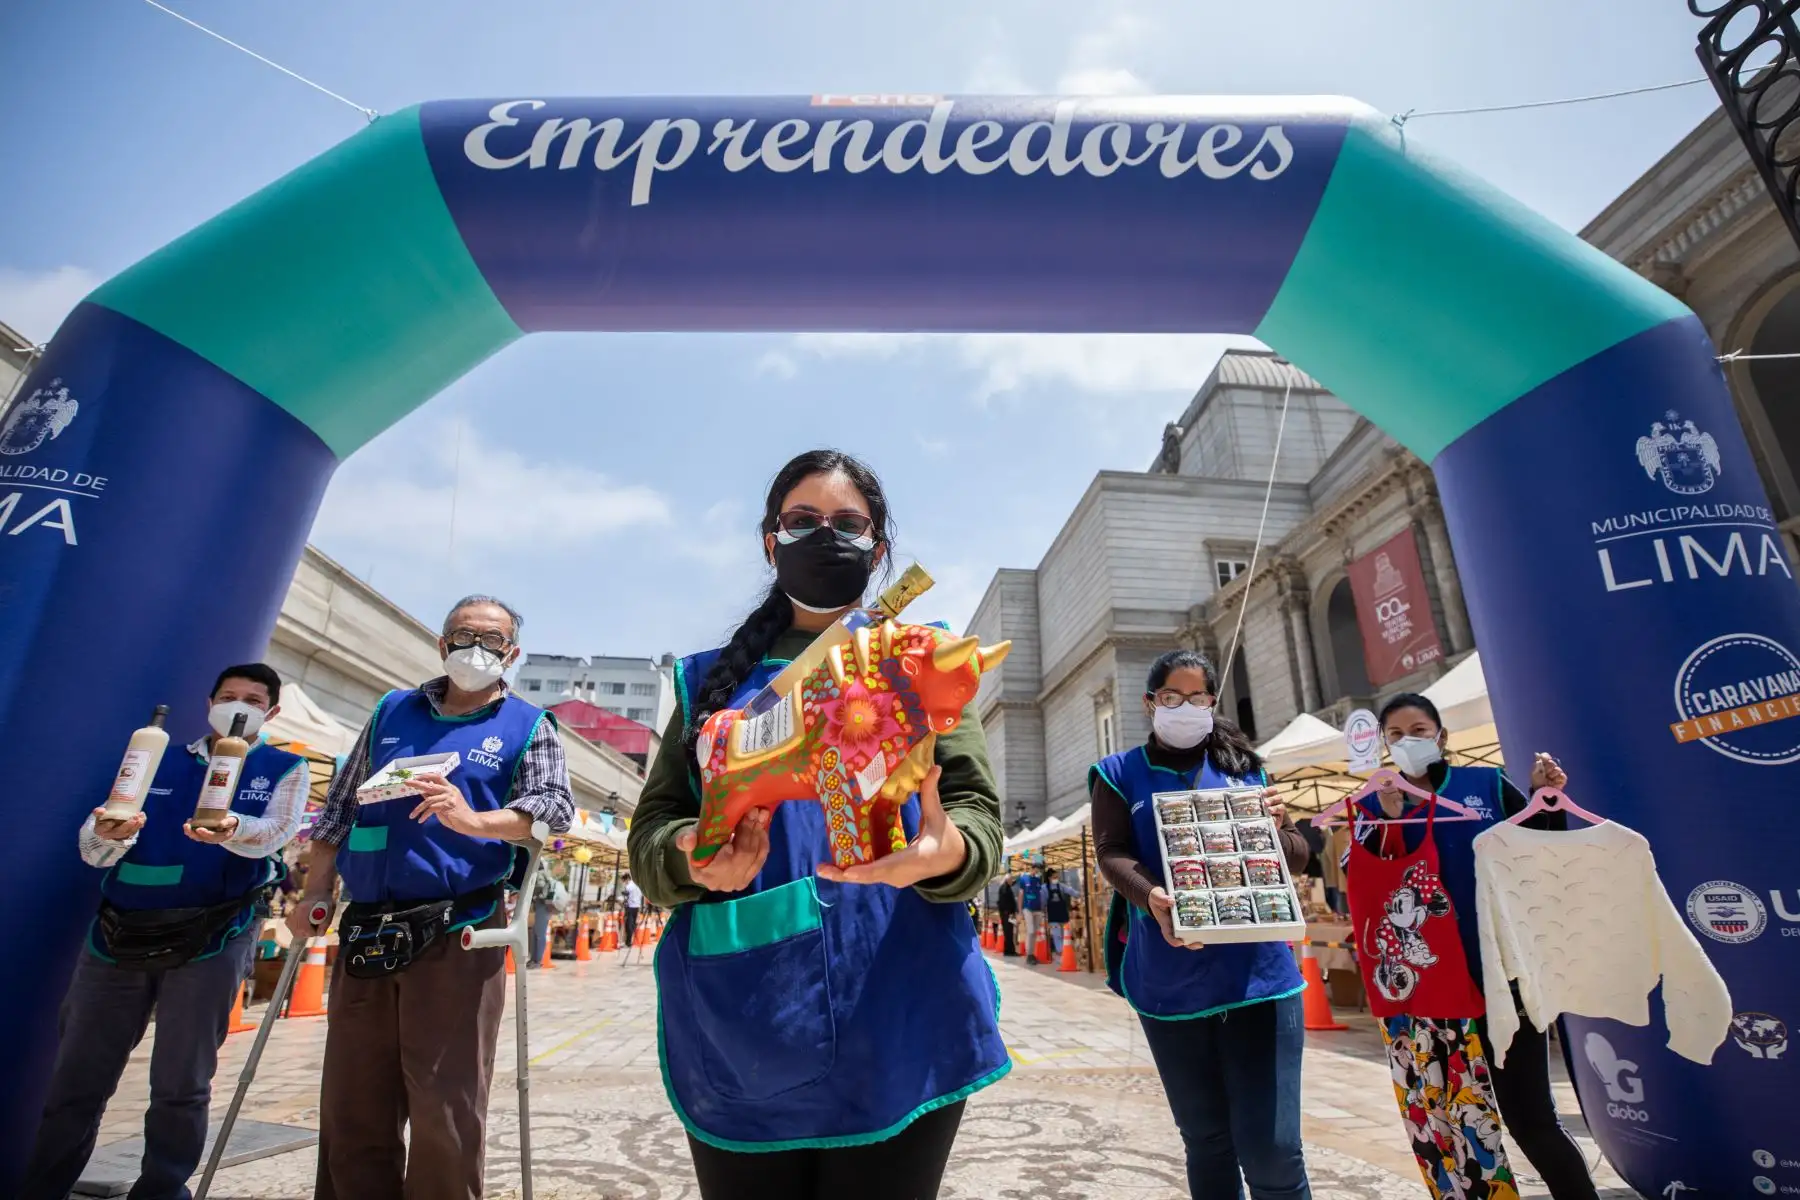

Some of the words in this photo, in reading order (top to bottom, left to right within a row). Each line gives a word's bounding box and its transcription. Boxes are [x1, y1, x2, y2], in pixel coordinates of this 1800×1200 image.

[463, 99, 1294, 206] Emprendedores
[73, 473, 108, 491] DE
[1591, 504, 1755, 535] MUNICIPALIDAD
[1757, 506, 1773, 522] DE
[1598, 532, 1792, 592] LIMA
[1692, 670, 1800, 714] CARAVANA
[1675, 697, 1800, 740] FINANCIE
[467, 752, 499, 771] LIMA
[239, 793, 270, 802] LIMA
[1606, 1102, 1650, 1122] Globo
